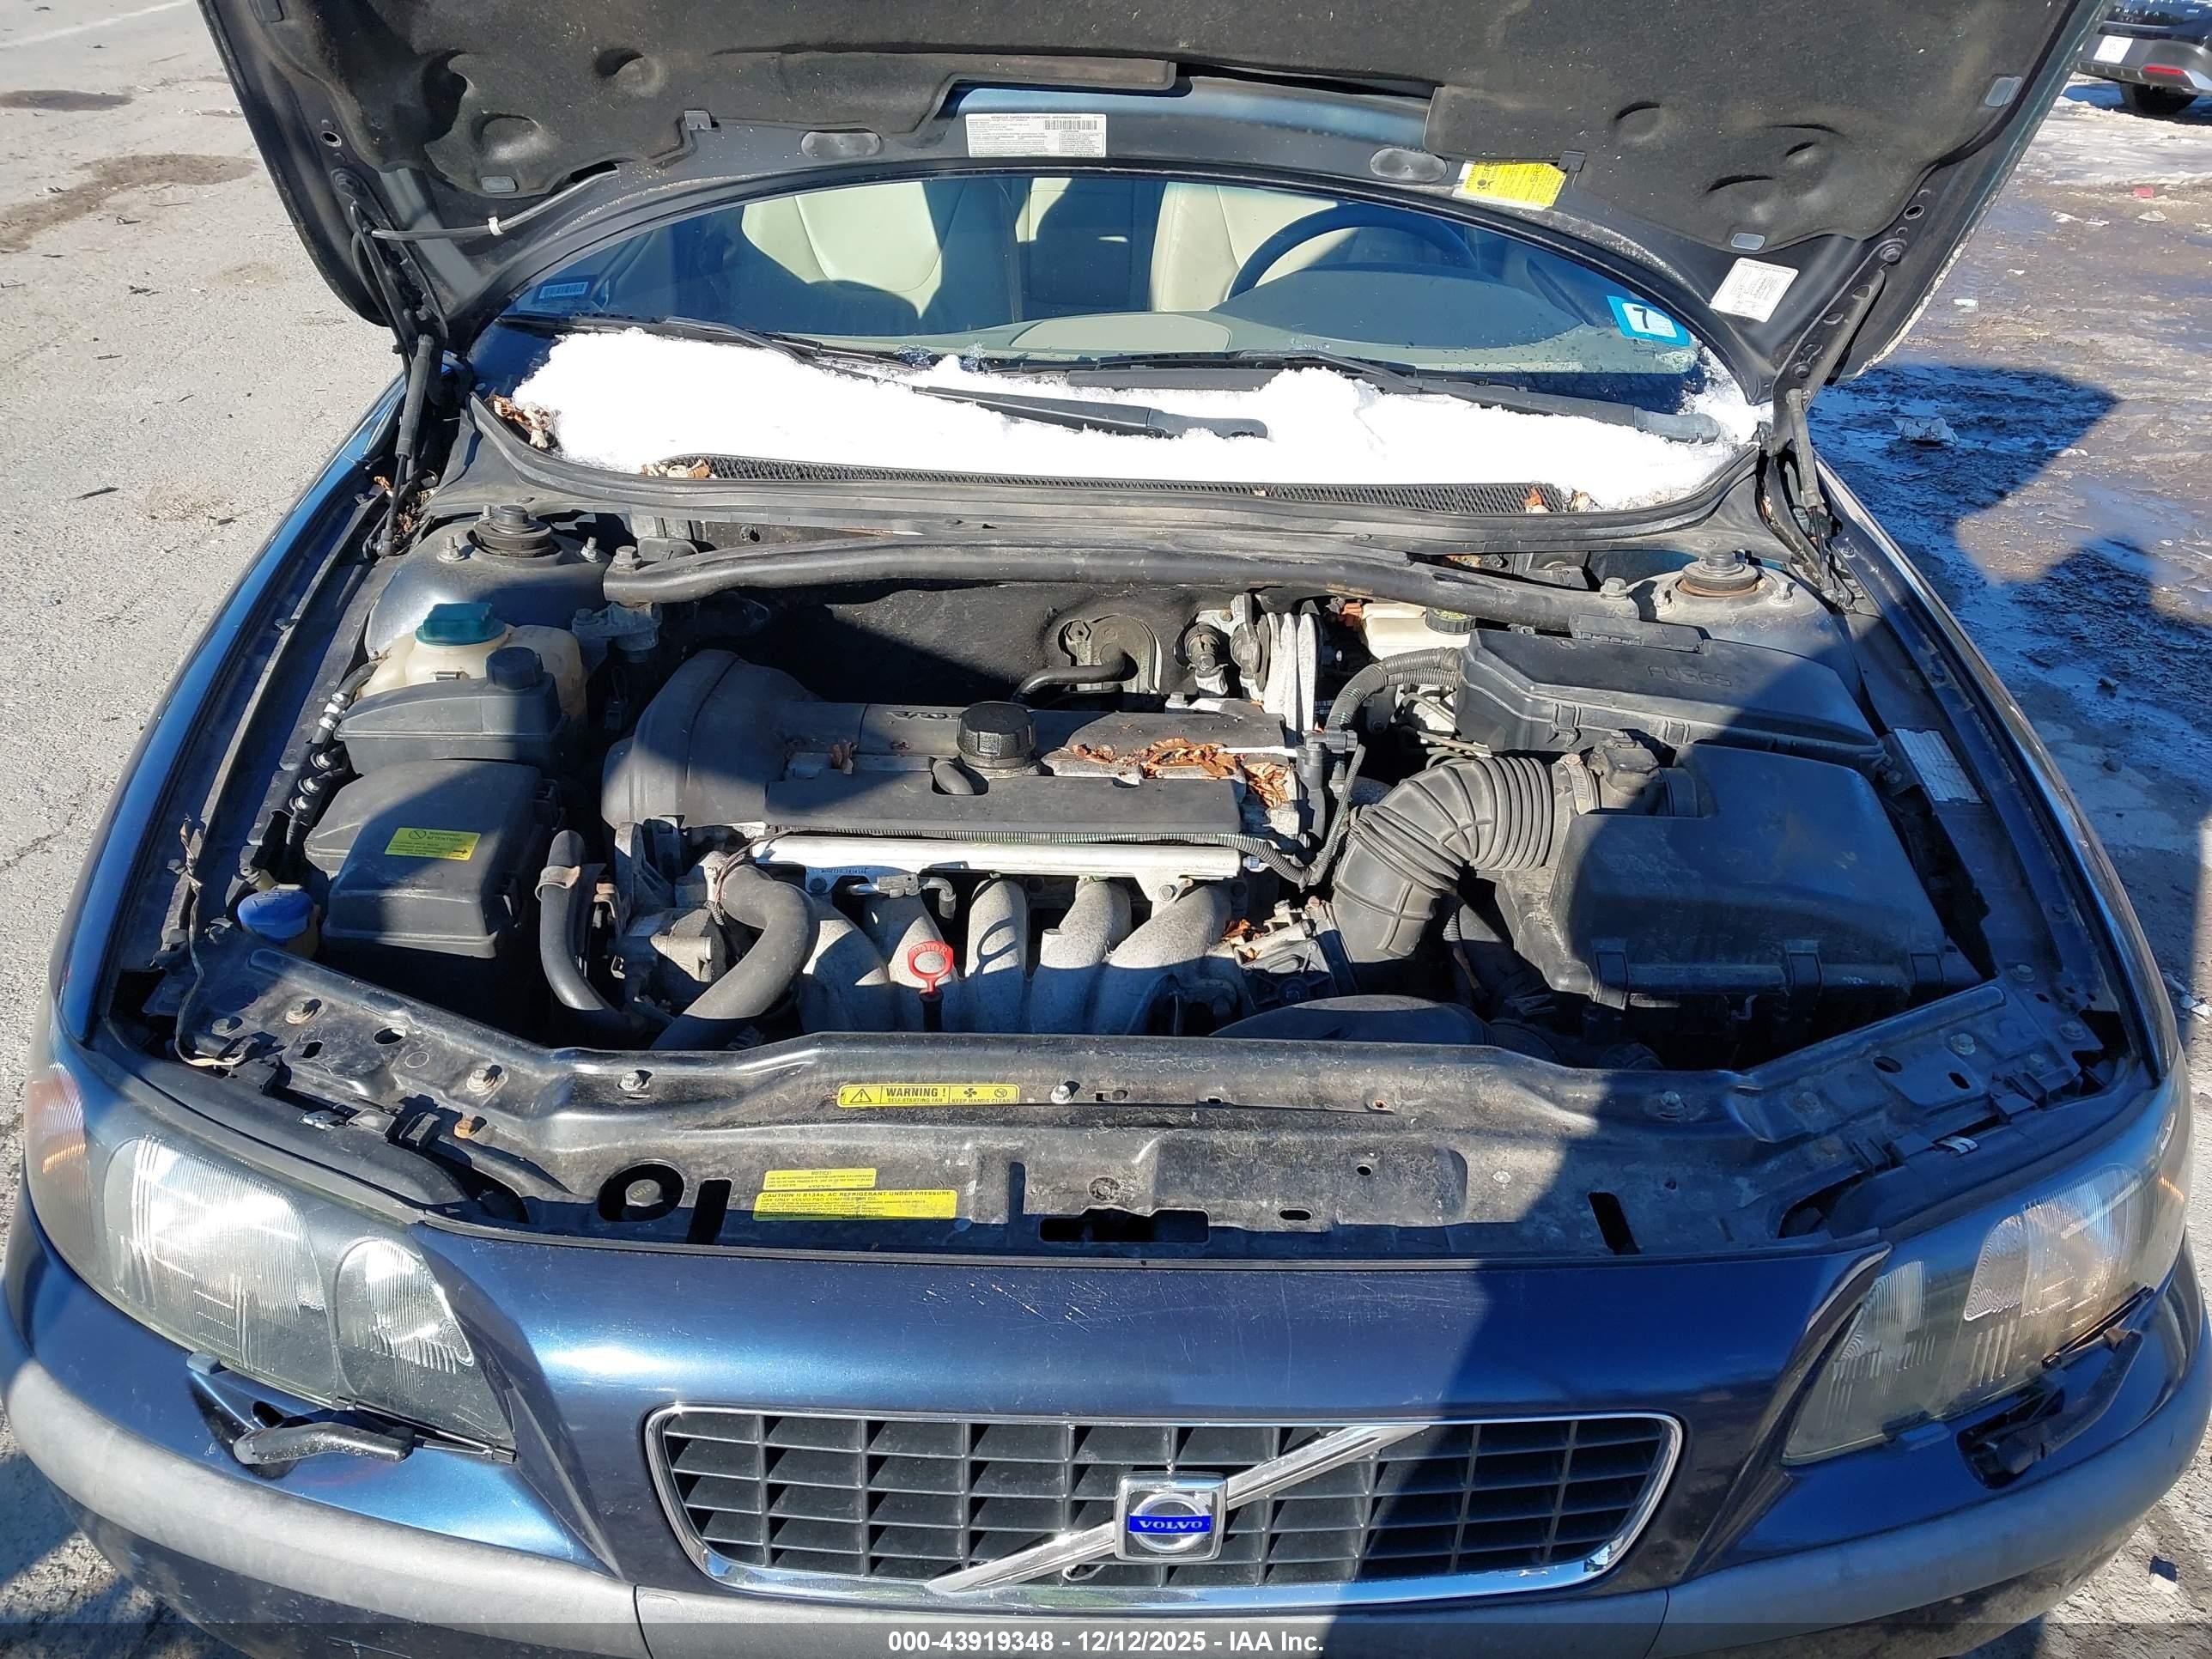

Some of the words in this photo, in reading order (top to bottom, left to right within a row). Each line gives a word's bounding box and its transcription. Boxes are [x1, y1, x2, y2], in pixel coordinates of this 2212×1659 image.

[1530, 163, 1544, 183] SRS
[1632, 307, 1650, 330] 7
[1647, 665, 1732, 687] FUSES
[886, 1087, 938, 1097] WARNING
[1139, 1520, 1203, 1529] VOLVO
